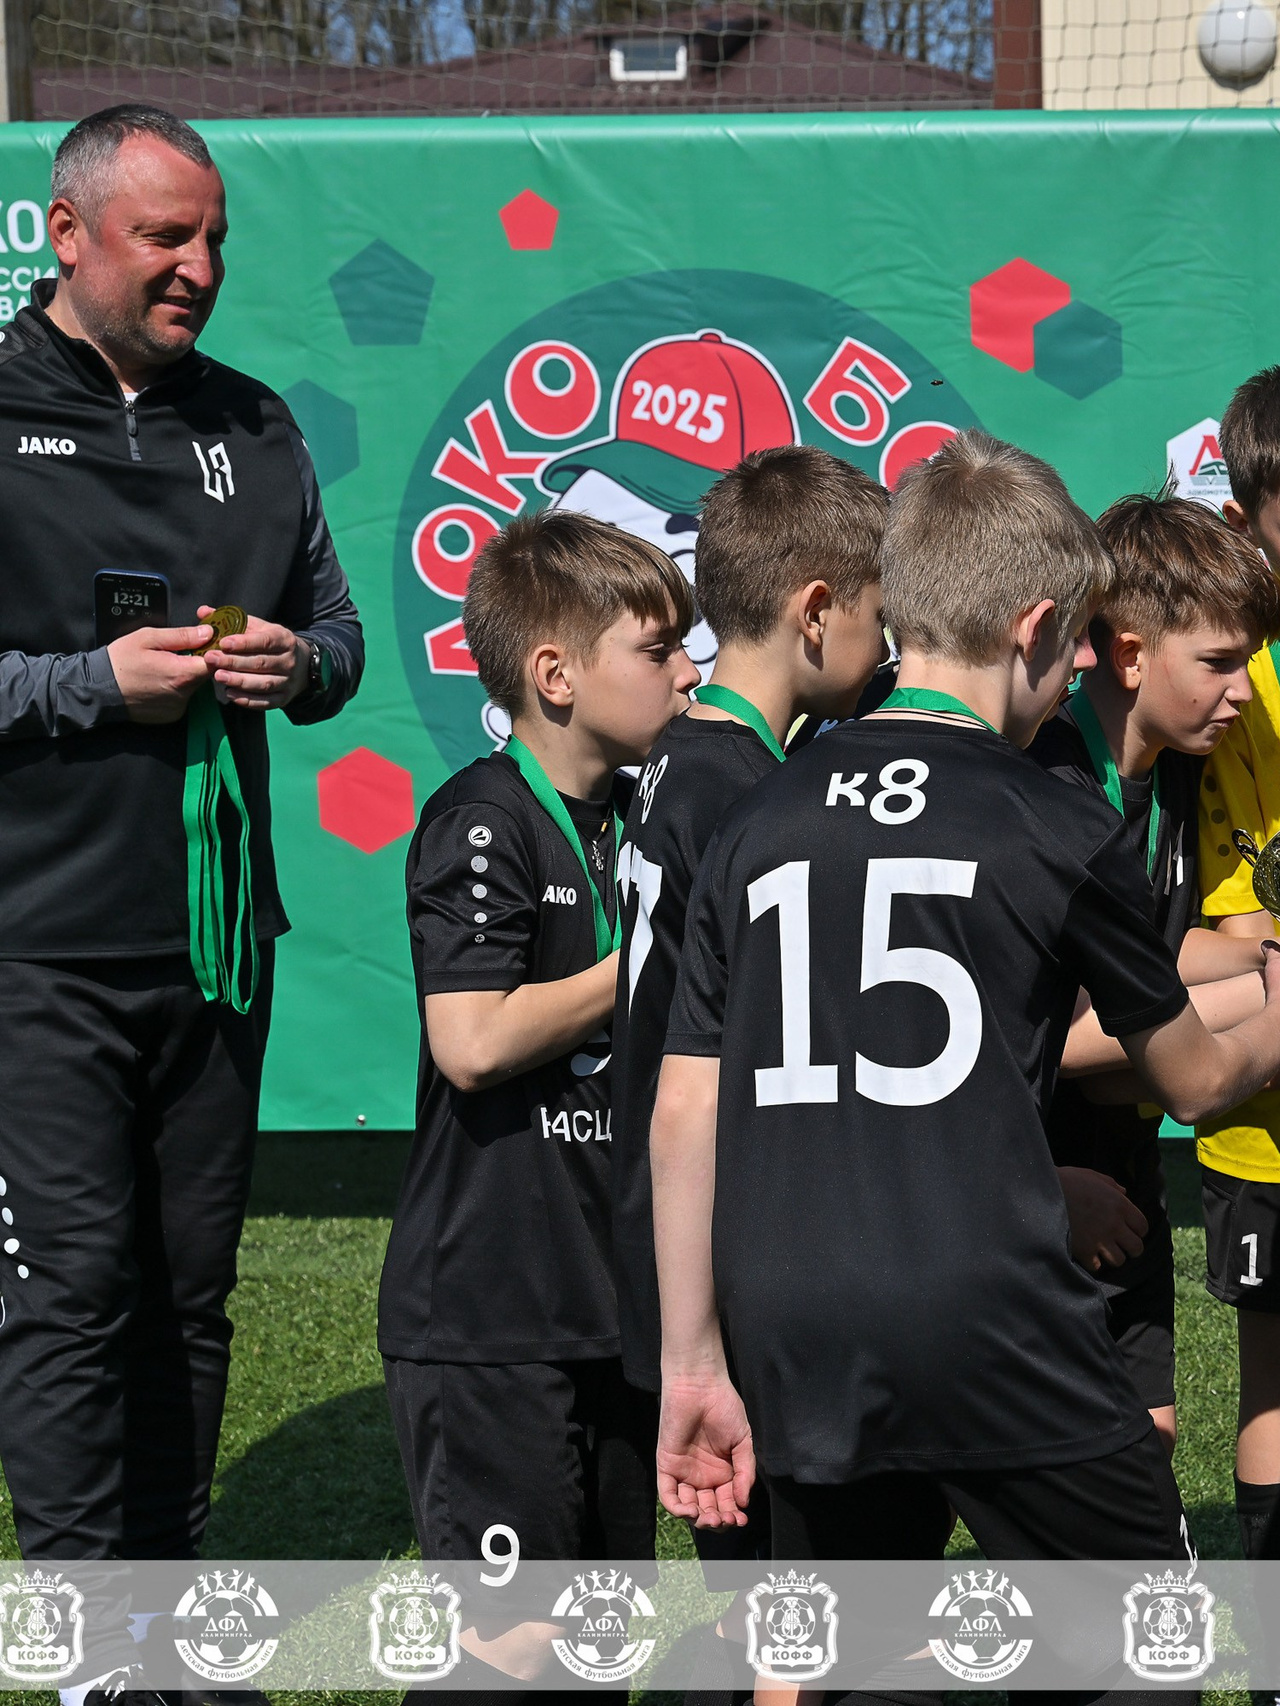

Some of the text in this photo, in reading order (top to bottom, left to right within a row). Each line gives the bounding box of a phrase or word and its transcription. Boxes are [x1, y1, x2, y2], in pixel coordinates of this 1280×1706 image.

[630, 380, 728, 443] 2025
[18, 436, 77, 456] JAKO
[113, 591, 149, 607] 12:21
[542, 884, 577, 906] AKO
[747, 857, 983, 1107] 15
[1240, 1233, 1263, 1286] 1
[479, 1523, 520, 1588] 9
